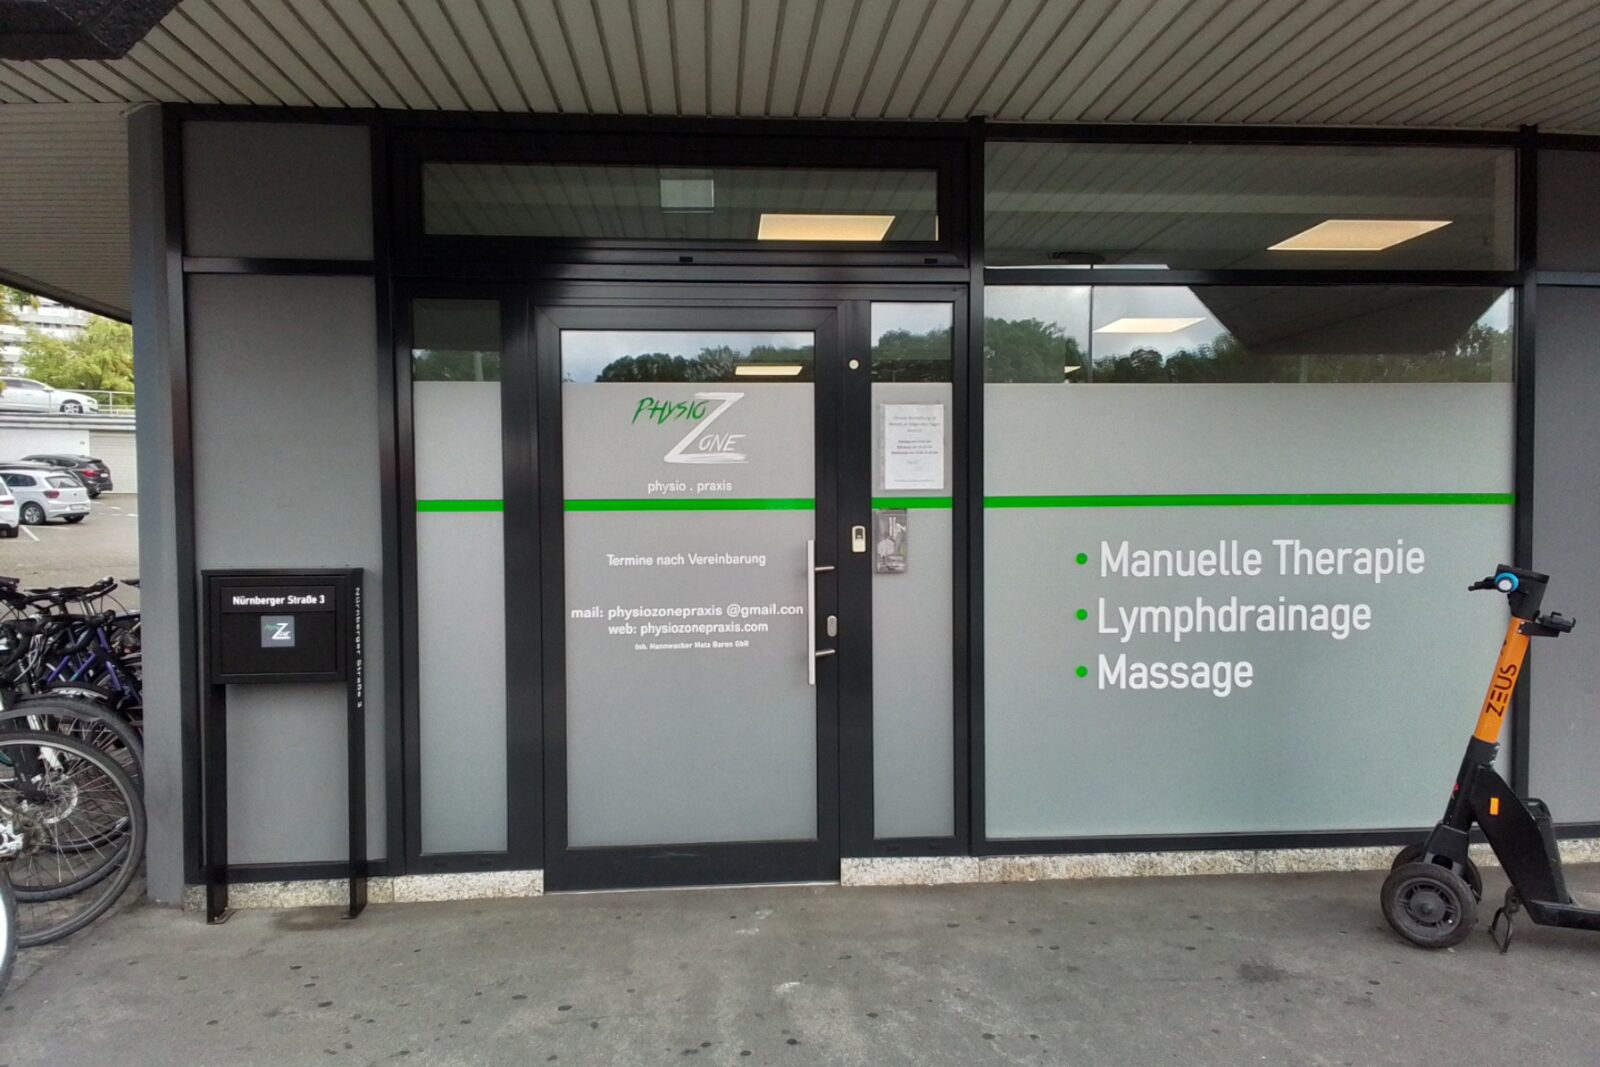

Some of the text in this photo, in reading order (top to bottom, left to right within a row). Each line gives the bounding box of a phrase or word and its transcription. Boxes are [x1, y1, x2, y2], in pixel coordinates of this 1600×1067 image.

[647, 479, 687, 495] physio
[696, 479, 733, 494] praxis
[606, 552, 767, 567] Termine nach Vereinbarung
[1100, 538, 1426, 584] Manuelle Therapie
[232, 594, 326, 607] Nürnberger Straße 3
[571, 606, 604, 619] mail:
[607, 605, 723, 621] physiozonepraxis
[1098, 595, 1373, 643] Lymphdrainage
[608, 621, 769, 637] web: physiozonepraxis.com
[1098, 653, 1255, 699] Massage
[1485, 664, 1517, 717] ZEUS
